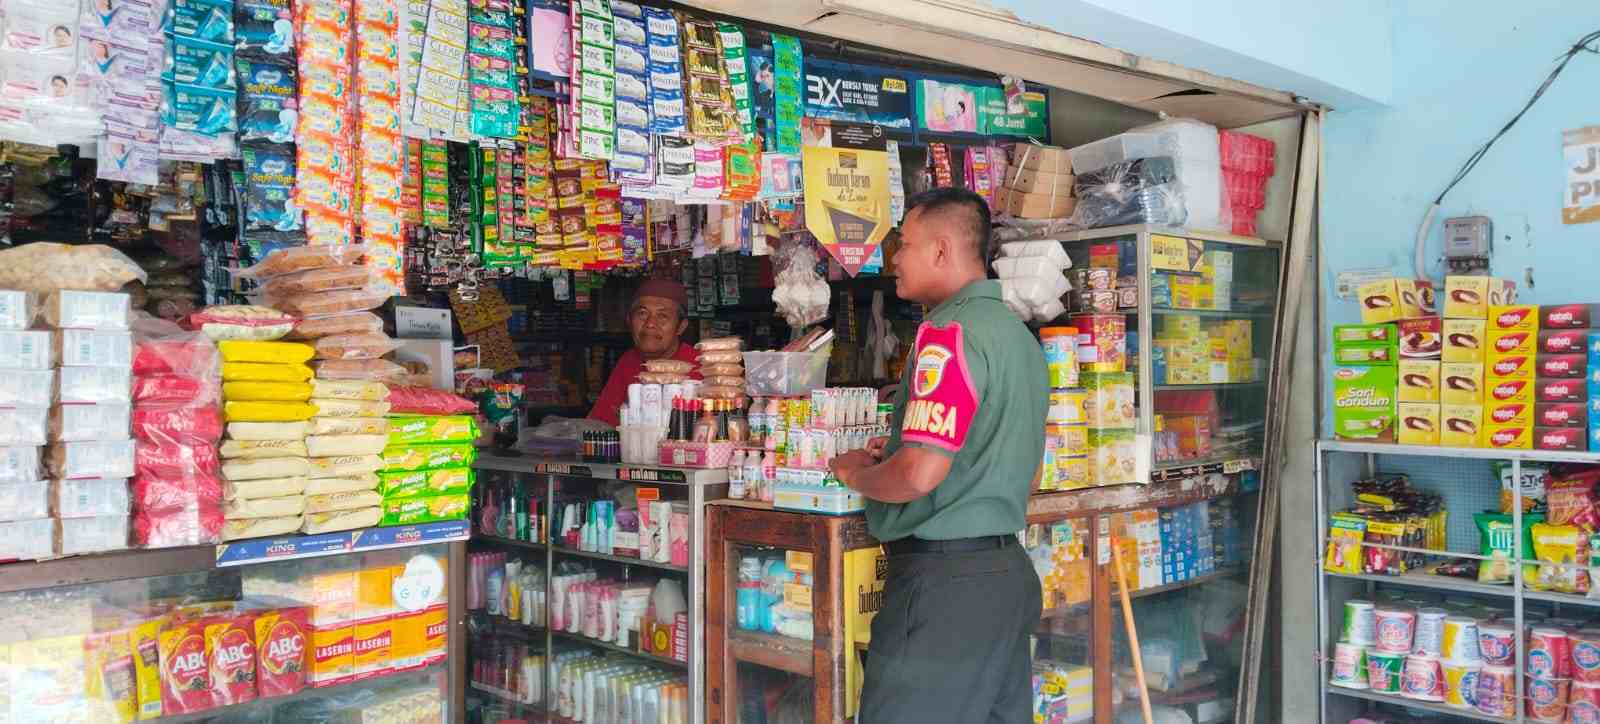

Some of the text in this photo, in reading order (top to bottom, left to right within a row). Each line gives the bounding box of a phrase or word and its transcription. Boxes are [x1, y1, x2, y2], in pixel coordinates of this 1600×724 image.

[805, 74, 844, 108] 3X
[1573, 147, 1600, 174] J
[1347, 386, 1377, 399] Sari
[1335, 396, 1391, 409] Gandum
[269, 635, 304, 658] ABC
[316, 643, 353, 658] LASERIN
[356, 636, 392, 651] LASERIN
[217, 642, 253, 666] ABC
